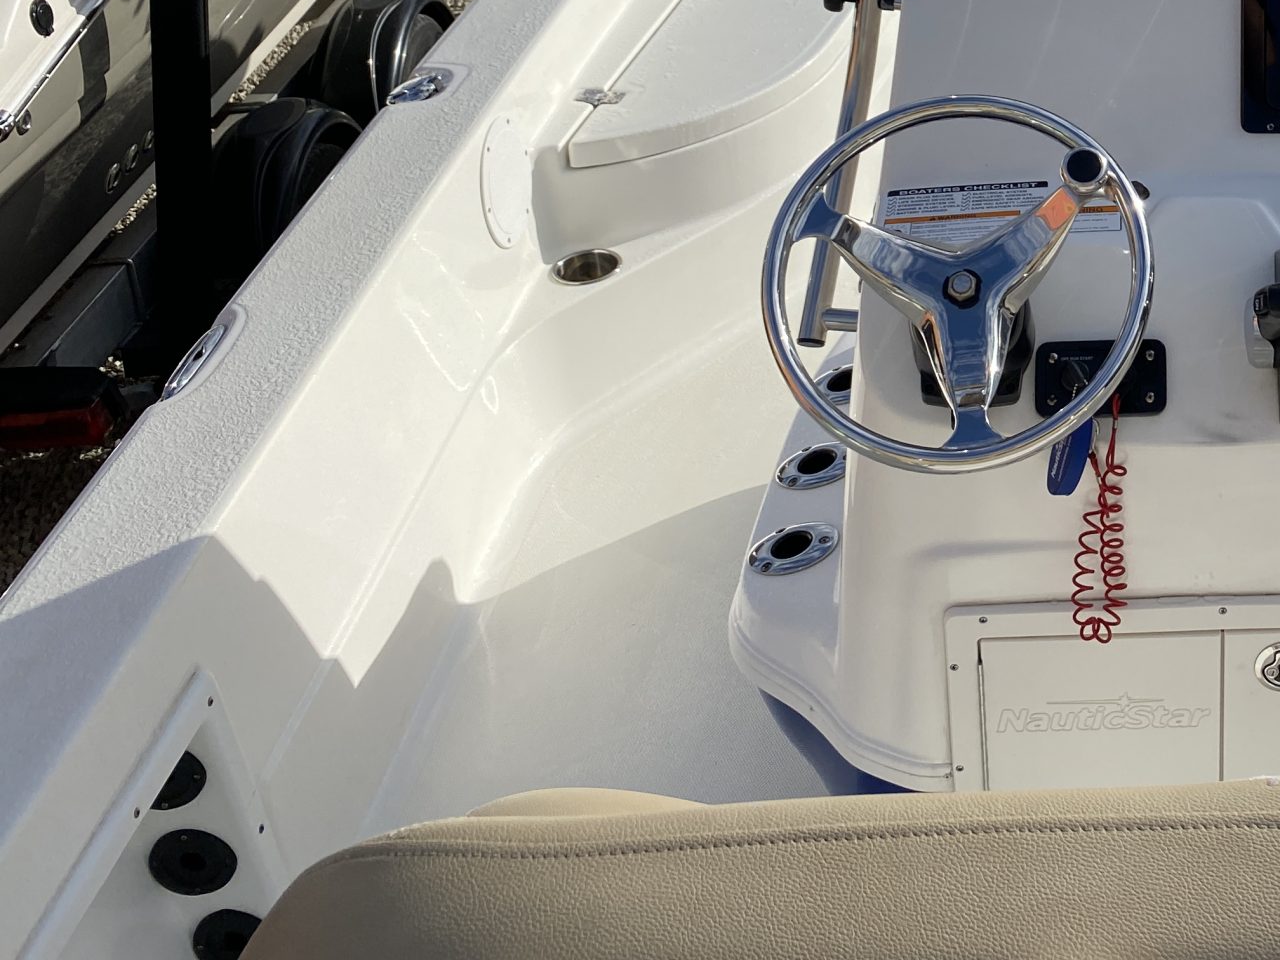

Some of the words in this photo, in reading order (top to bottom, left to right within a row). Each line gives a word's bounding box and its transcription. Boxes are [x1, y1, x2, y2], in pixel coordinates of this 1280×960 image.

[900, 187, 960, 196] BOATERS
[964, 182, 1038, 191] CHECKLIST
[996, 705, 1211, 733] NauticStar
